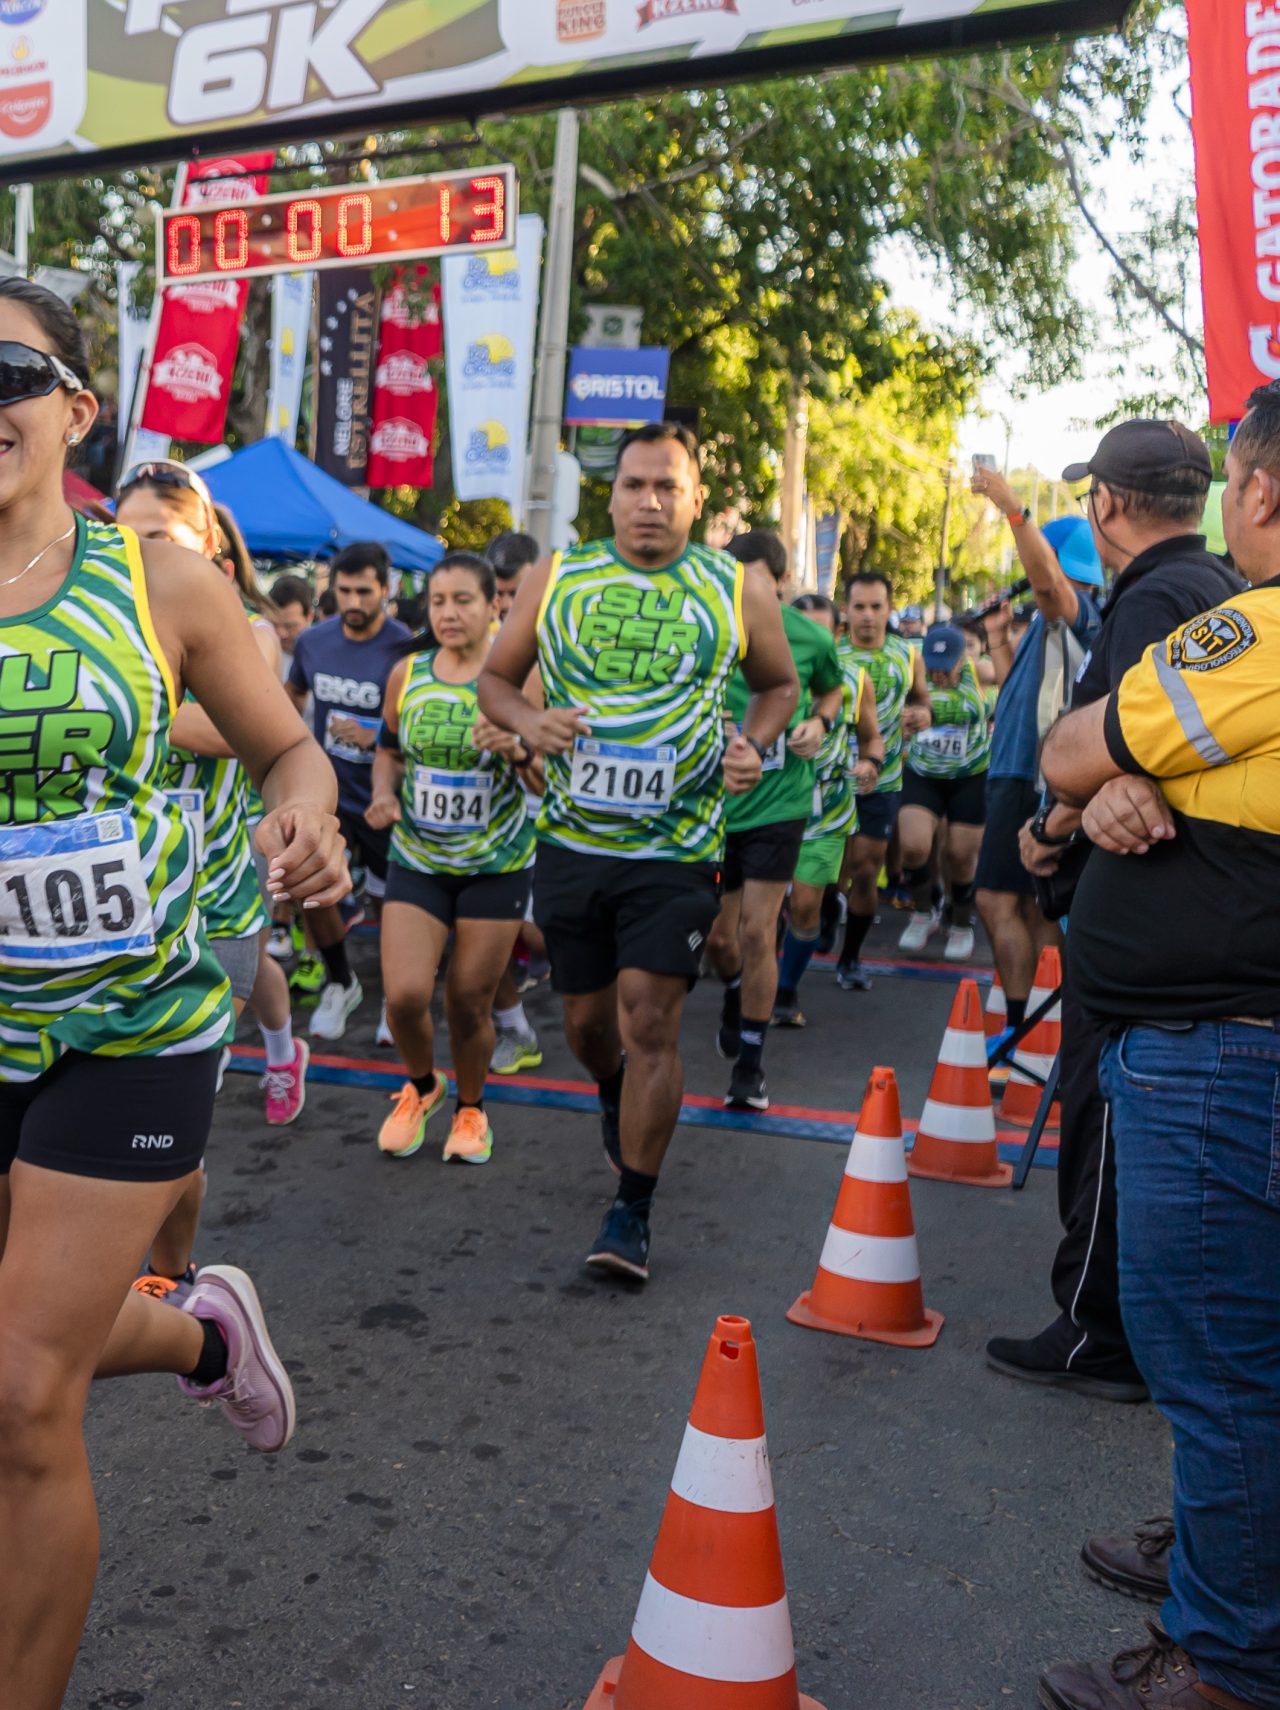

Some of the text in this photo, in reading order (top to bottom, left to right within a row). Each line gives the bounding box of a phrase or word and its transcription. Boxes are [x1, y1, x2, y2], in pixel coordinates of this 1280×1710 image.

[559, 14, 605, 32] KING
[1244, 0, 1280, 303] GATORADE
[168, 176, 505, 276] 00 00 13
[346, 291, 375, 470] ESTRELLITA
[574, 373, 665, 400] BRISTOL
[332, 377, 354, 456] NELORE
[598, 584, 687, 621] SU
[577, 614, 701, 654] PER
[1191, 625, 1224, 652] SIT
[593, 648, 681, 684] 6K
[313, 672, 381, 709] BIGG
[422, 701, 479, 726] SU
[579, 761, 665, 802] 2104
[420, 790, 483, 821] 1934
[131, 1134, 174, 1149] RND
